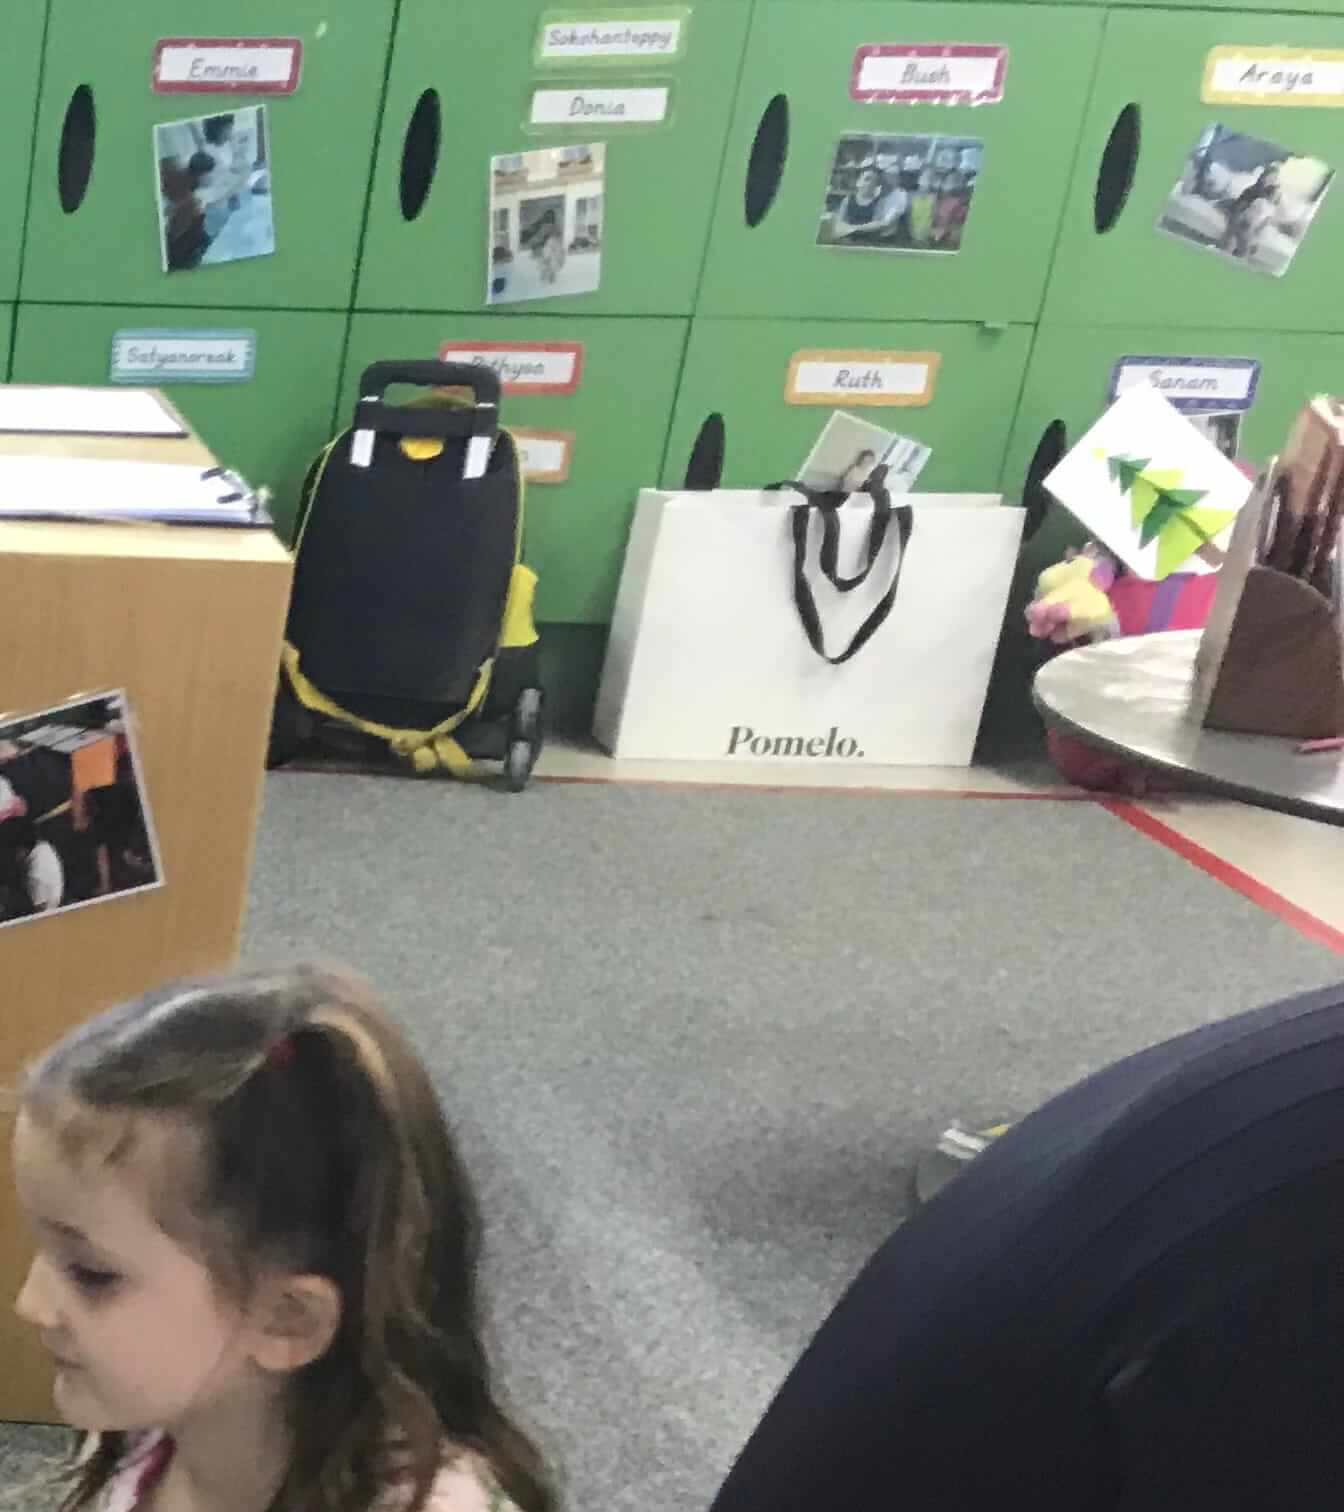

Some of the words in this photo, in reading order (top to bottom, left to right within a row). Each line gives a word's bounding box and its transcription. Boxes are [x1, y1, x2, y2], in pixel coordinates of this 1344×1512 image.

[1240, 63, 1314, 92] Araya
[833, 368, 883, 389] Ruth
[725, 725, 865, 759] Pomelo.
